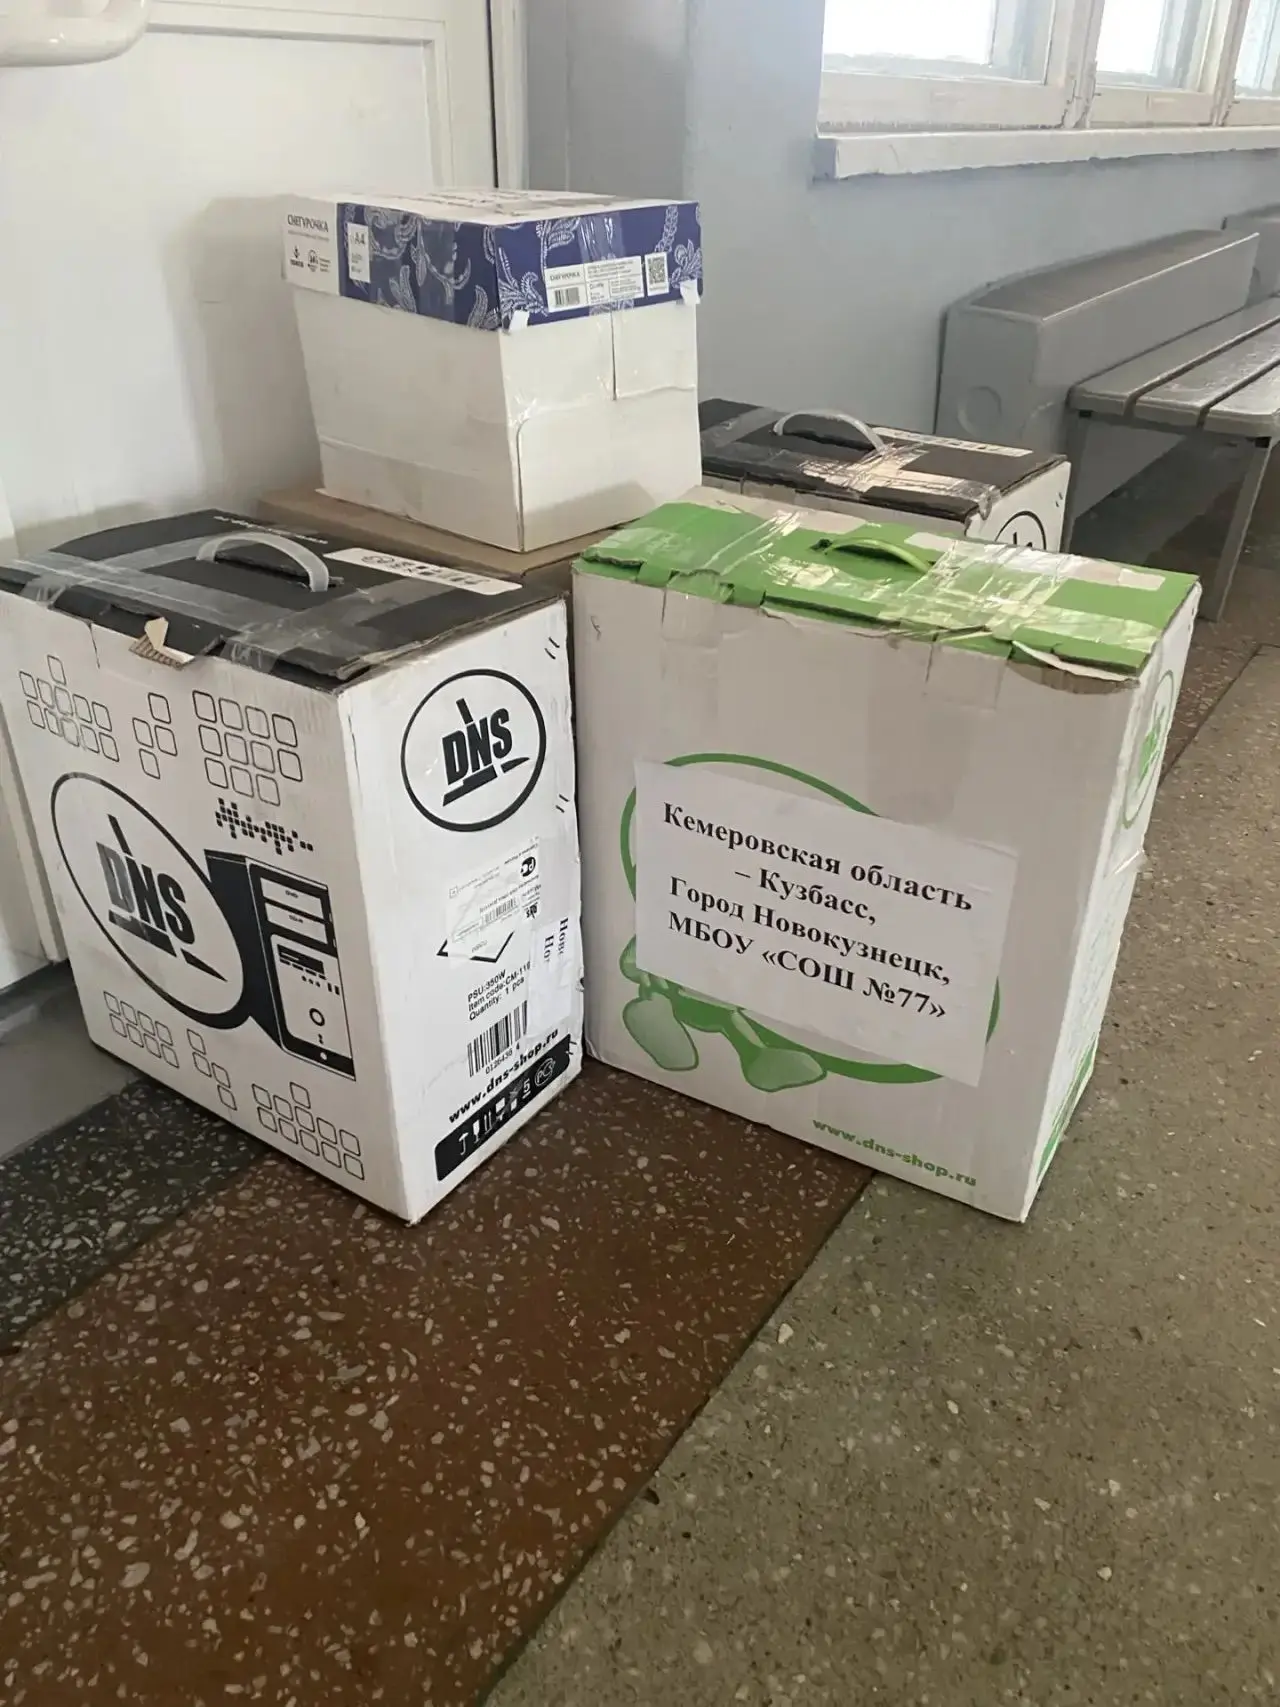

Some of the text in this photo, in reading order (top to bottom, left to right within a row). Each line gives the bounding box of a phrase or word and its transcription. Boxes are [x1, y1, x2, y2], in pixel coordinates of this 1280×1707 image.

[442, 698, 513, 786] DNS
[96, 814, 197, 947] DNS
[664, 802, 973, 910] Кемеровская область
[759, 868, 876, 925] Кузбасс,
[668, 910, 947, 1018] МБОУ «СОШ №77»
[669, 876, 950, 985] Город Новокузнецк,
[468, 998, 485, 1012] Item
[449, 1029, 558, 1123] www.dns-shop.ru
[813, 1119, 977, 1187] www.dns-shop.ru
